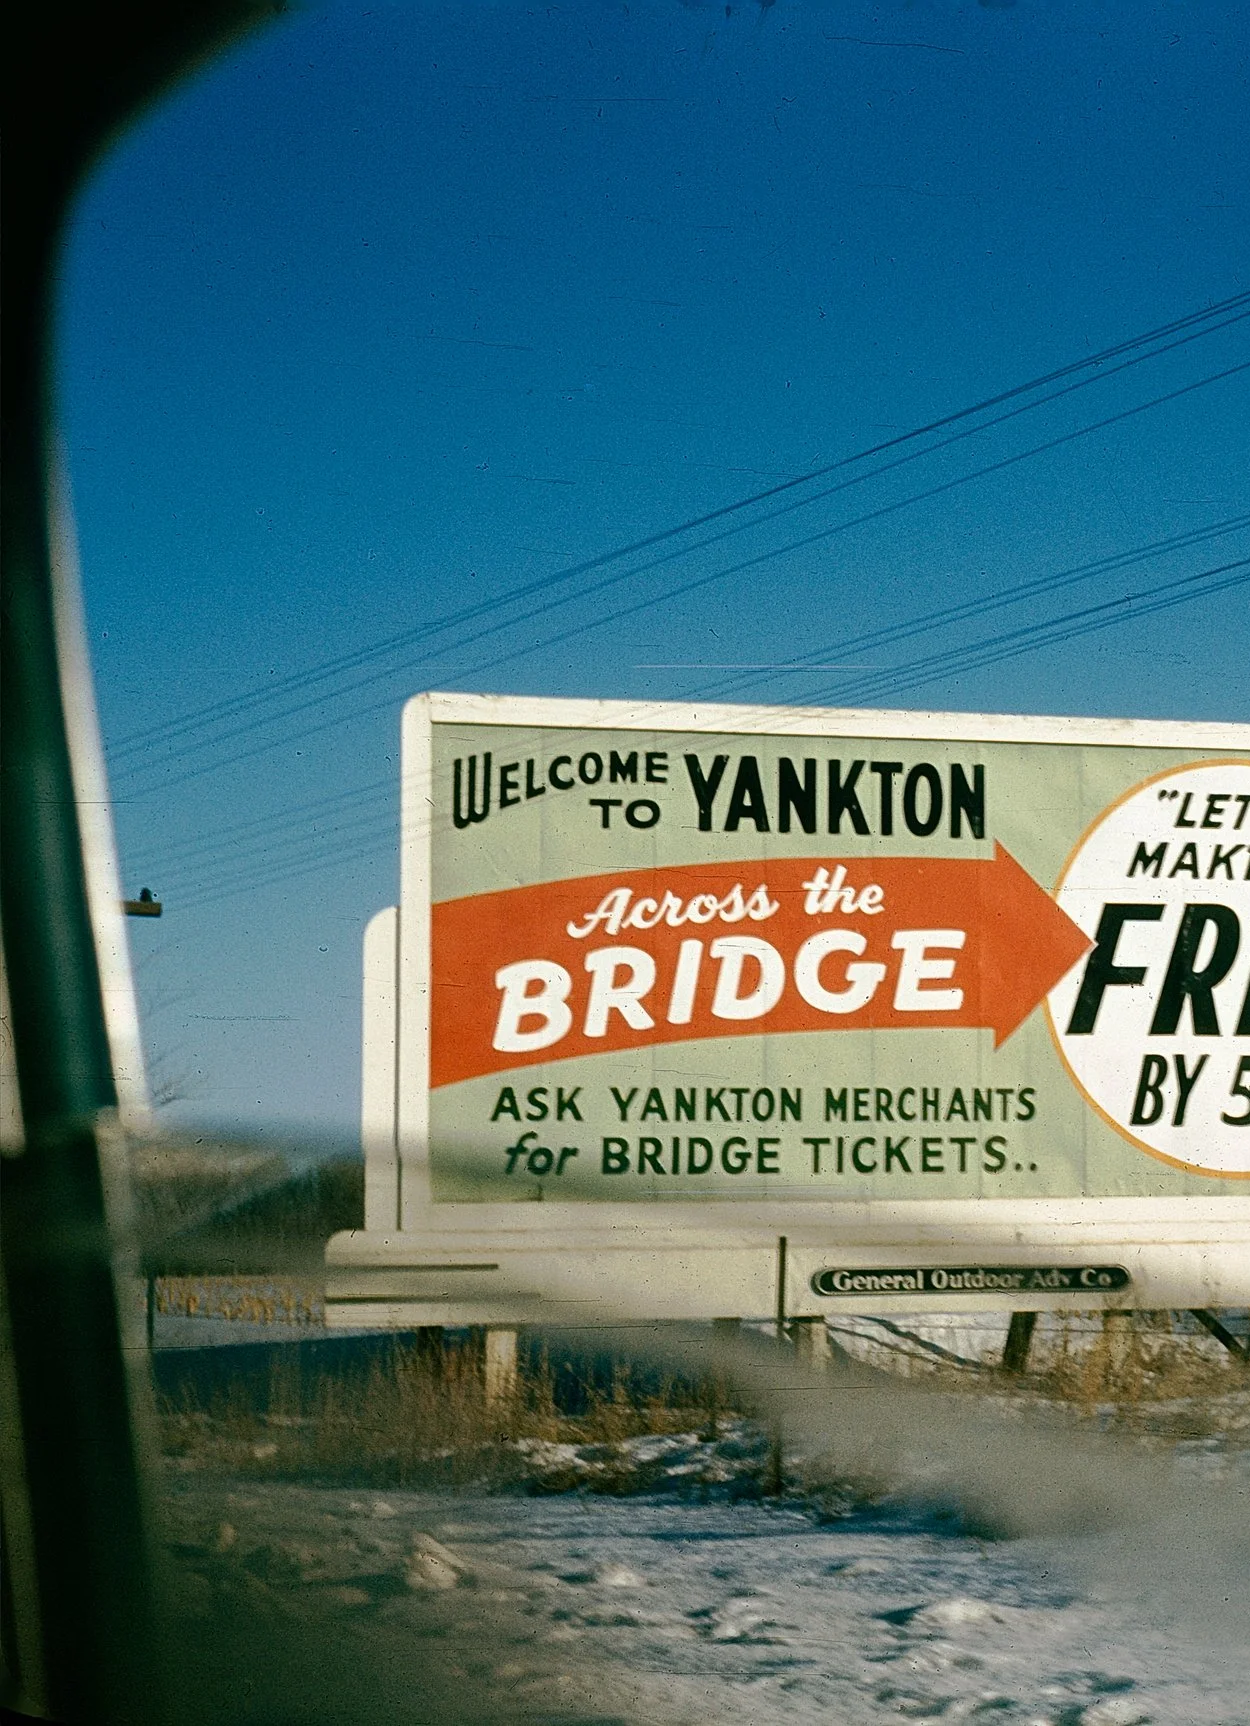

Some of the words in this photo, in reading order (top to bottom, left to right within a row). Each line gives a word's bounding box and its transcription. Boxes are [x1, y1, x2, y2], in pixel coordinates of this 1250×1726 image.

[452, 750, 670, 829] WELCOME
[590, 799, 660, 829] TO
[685, 753, 986, 839] YANKTON
[566, 886, 780, 939] Across
[802, 865, 885, 916] the
[492, 928, 966, 1053] BRIDGE
[490, 1086, 583, 1123] ASK
[610, 1086, 802, 1123] YANKTON
[824, 1086, 1037, 1123] MERCHANTS
[1129, 1054, 1209, 1127] BY
[504, 1131, 577, 1176] for
[601, 1136, 780, 1175] BRIDGE
[832, 1269, 924, 1290] General
[931, 1268, 1021, 1290] Outdoor
